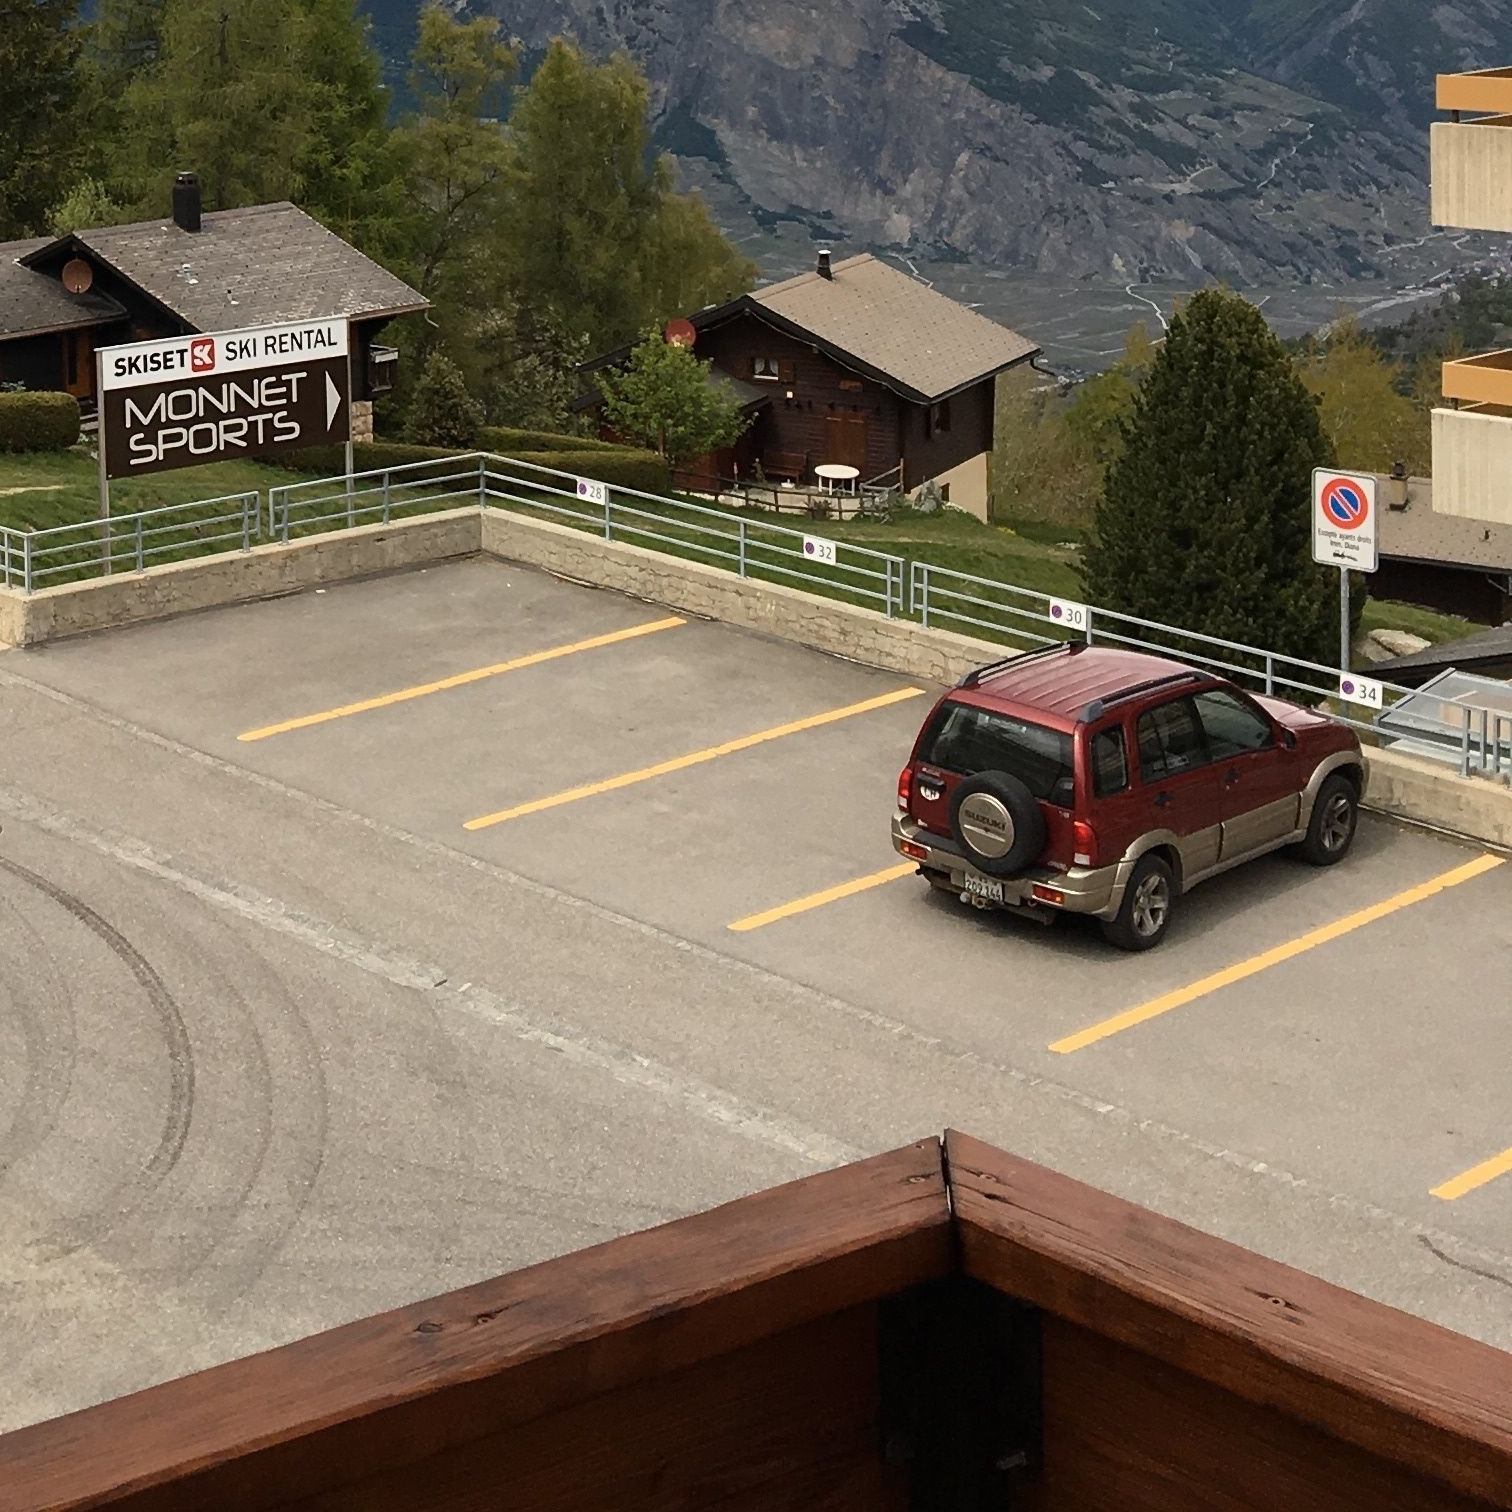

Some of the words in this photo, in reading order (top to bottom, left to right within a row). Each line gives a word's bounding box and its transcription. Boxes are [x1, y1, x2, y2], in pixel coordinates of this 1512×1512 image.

[114, 349, 189, 377] SKISET
[225, 338, 257, 361] SKI
[264, 327, 338, 355] RENTAL
[125, 372, 308, 428] MONNET
[129, 410, 301, 465] SPORTS
[590, 485, 602, 499] 28
[818, 544, 831, 559] 32
[1066, 608, 1081, 624] 30
[1359, 684, 1376, 701] 34
[965, 808, 1006, 831] SUZUKI
